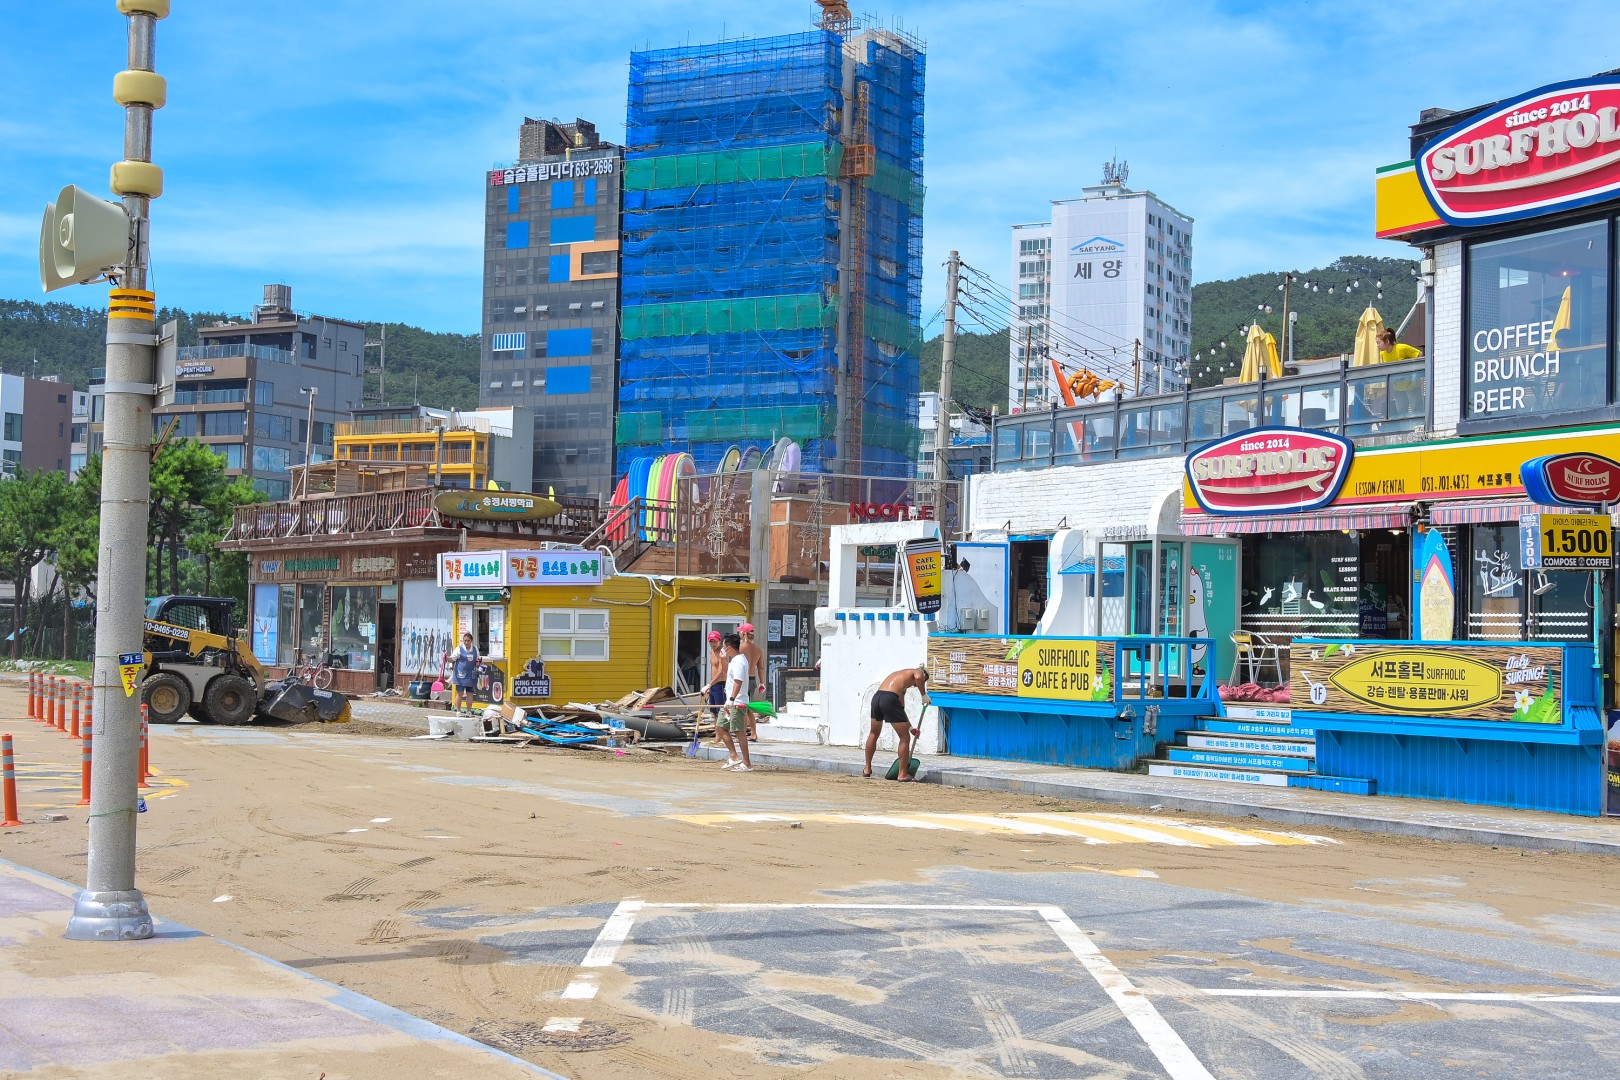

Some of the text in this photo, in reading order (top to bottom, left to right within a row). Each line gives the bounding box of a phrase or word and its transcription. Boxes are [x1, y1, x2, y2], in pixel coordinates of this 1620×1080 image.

[1505, 93, 1591, 128] since 2014
[504, 159, 613, 184] 술술풀립니다 633-2696
[1474, 320, 1554, 352] COFFEE
[1474, 350, 1560, 383] BRUNCH
[1474, 386, 1525, 414] BEER
[1240, 438, 1290, 452] since 2014
[1193, 446, 1336, 481] SURFHOLIC
[1422, 474, 1469, 491] 051.701.4851
[1478, 472, 1512, 486] 서프홀릭
[1566, 474, 1606, 486] SURF HOLIC
[482, 496, 534, 508] 송정서핑학교
[850, 501, 934, 520] NOODE
[1570, 518, 1599, 526] 아메리카노
[1544, 529, 1608, 554] 1,500
[863, 546, 898, 558] Chapl
[445, 559, 462, 580] 킹콩
[464, 562, 480, 576] 토스트
[487, 560, 499, 578] 와플
[510, 556, 538, 580] 킹콩
[542, 560, 568, 576] 토스트
[580, 560, 598, 576] 와플
[916, 564, 936, 572] HOLIC
[1544, 558, 1610, 566] COMPOSE COFFEE
[1490, 567, 1518, 590] Sea
[124, 656, 142, 664] 카드
[950, 652, 966, 662] COFFEE
[1038, 648, 1090, 668] SURFHOLIC
[1506, 654, 1530, 669] Only
[950, 663, 961, 672] BEER
[982, 664, 1005, 675] 서프홀릭
[1371, 661, 1465, 680] 서프홀릭 SURFHOLIC
[1506, 666, 1545, 684] SURFING!
[1000, 677, 1017, 688] 주차장
[1023, 671, 1089, 690] 2F CAFE & PUB
[514, 686, 548, 694] COFFEE
[1314, 686, 1323, 700] 1F
